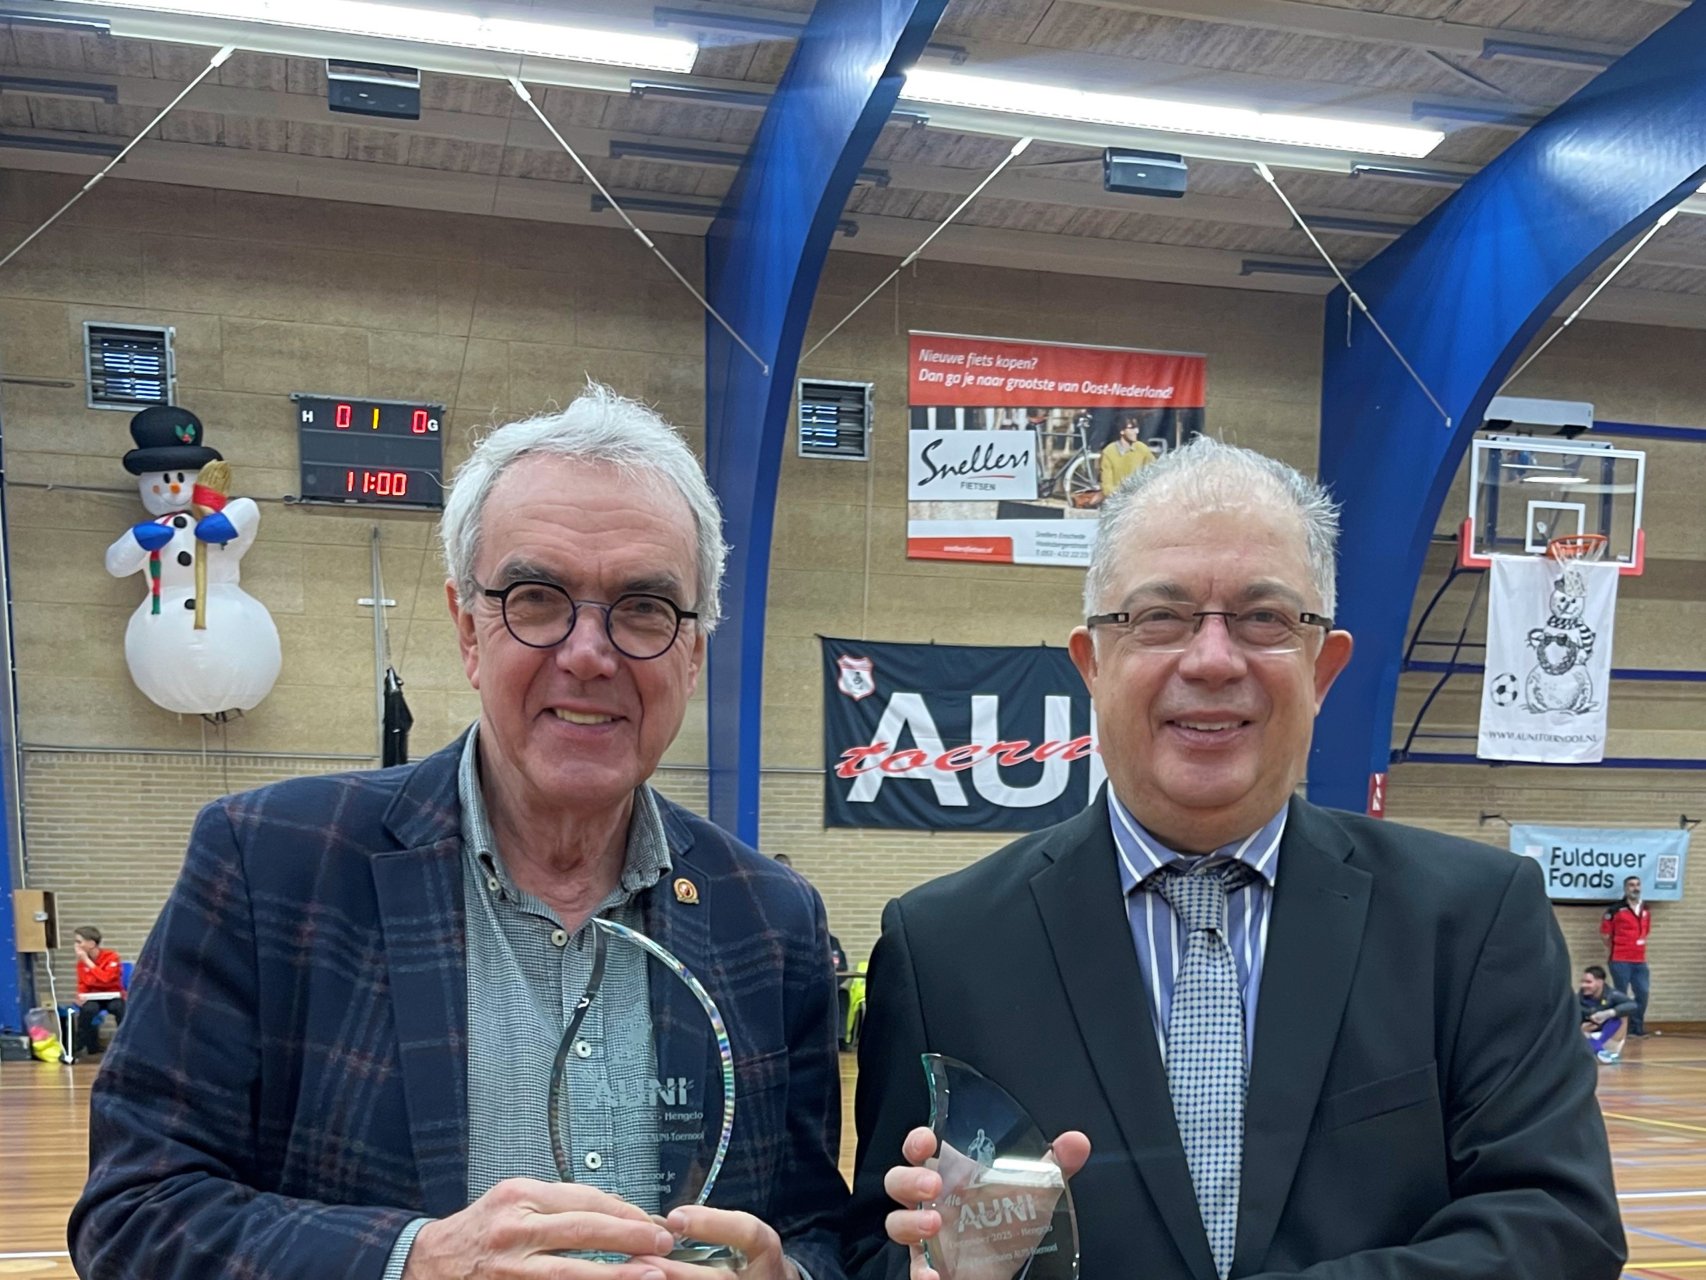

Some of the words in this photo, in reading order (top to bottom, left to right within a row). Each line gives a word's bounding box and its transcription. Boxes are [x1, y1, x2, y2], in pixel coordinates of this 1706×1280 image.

[918, 349, 965, 365] Nieuwe
[966, 352, 994, 369] fiets
[995, 354, 1039, 371] kopen?
[918, 368, 944, 382] Dan
[945, 373, 961, 387] ga
[961, 372, 976, 388] je
[976, 374, 1005, 387] naar
[1005, 376, 1056, 392] grootste
[1057, 381, 1079, 393] van
[1081, 380, 1174, 399] Oost-Nederland!
[301, 410, 314, 423] H
[427, 419, 439, 431] G
[917, 438, 1029, 486] Snellers
[347, 471, 407, 496] 11:00
[960, 481, 996, 491] FIETSEN
[834, 735, 1102, 778] toern
[846, 692, 1107, 808] AU
[1550, 847, 1646, 868] Fuldauer
[1549, 868, 1614, 889] Fonds
[664, 1111, 704, 1122] Hengelo
[958, 1193, 1037, 1233] AUNI
